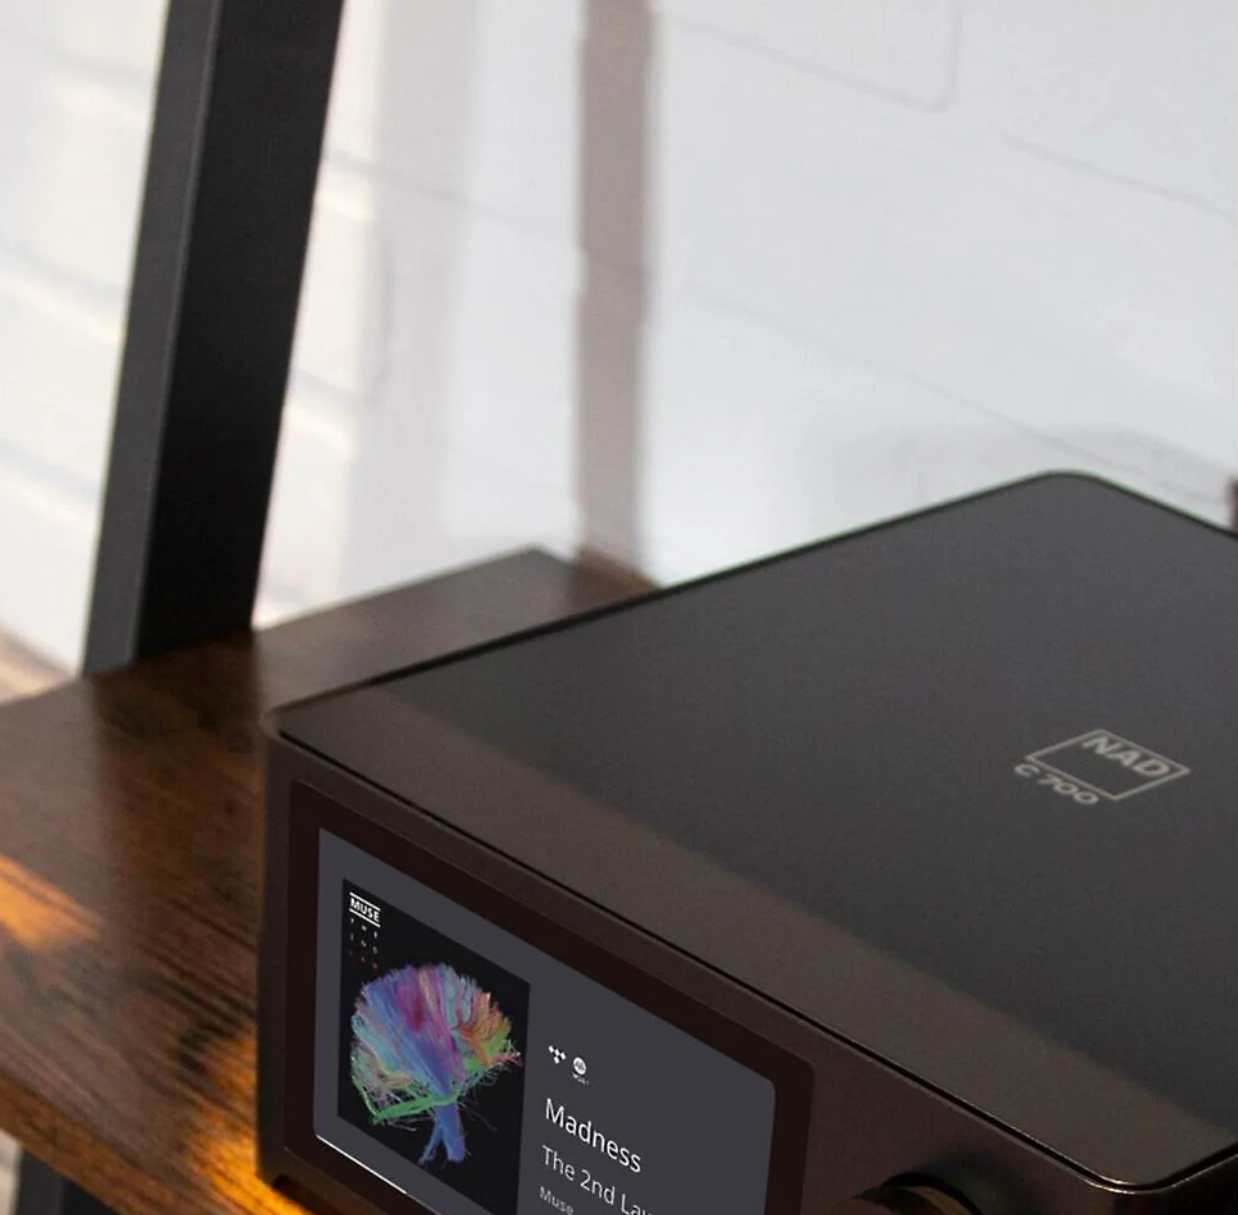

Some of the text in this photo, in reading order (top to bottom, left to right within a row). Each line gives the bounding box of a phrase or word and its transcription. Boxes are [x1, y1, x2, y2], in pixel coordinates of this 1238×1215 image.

[1082, 736, 1170, 778] NAD
[1014, 763, 1101, 805] C 700
[350, 897, 380, 923] MUSE
[545, 1097, 642, 1173] Madness
[542, 1144, 576, 1182] The
[580, 1169, 616, 1206] 2nd
